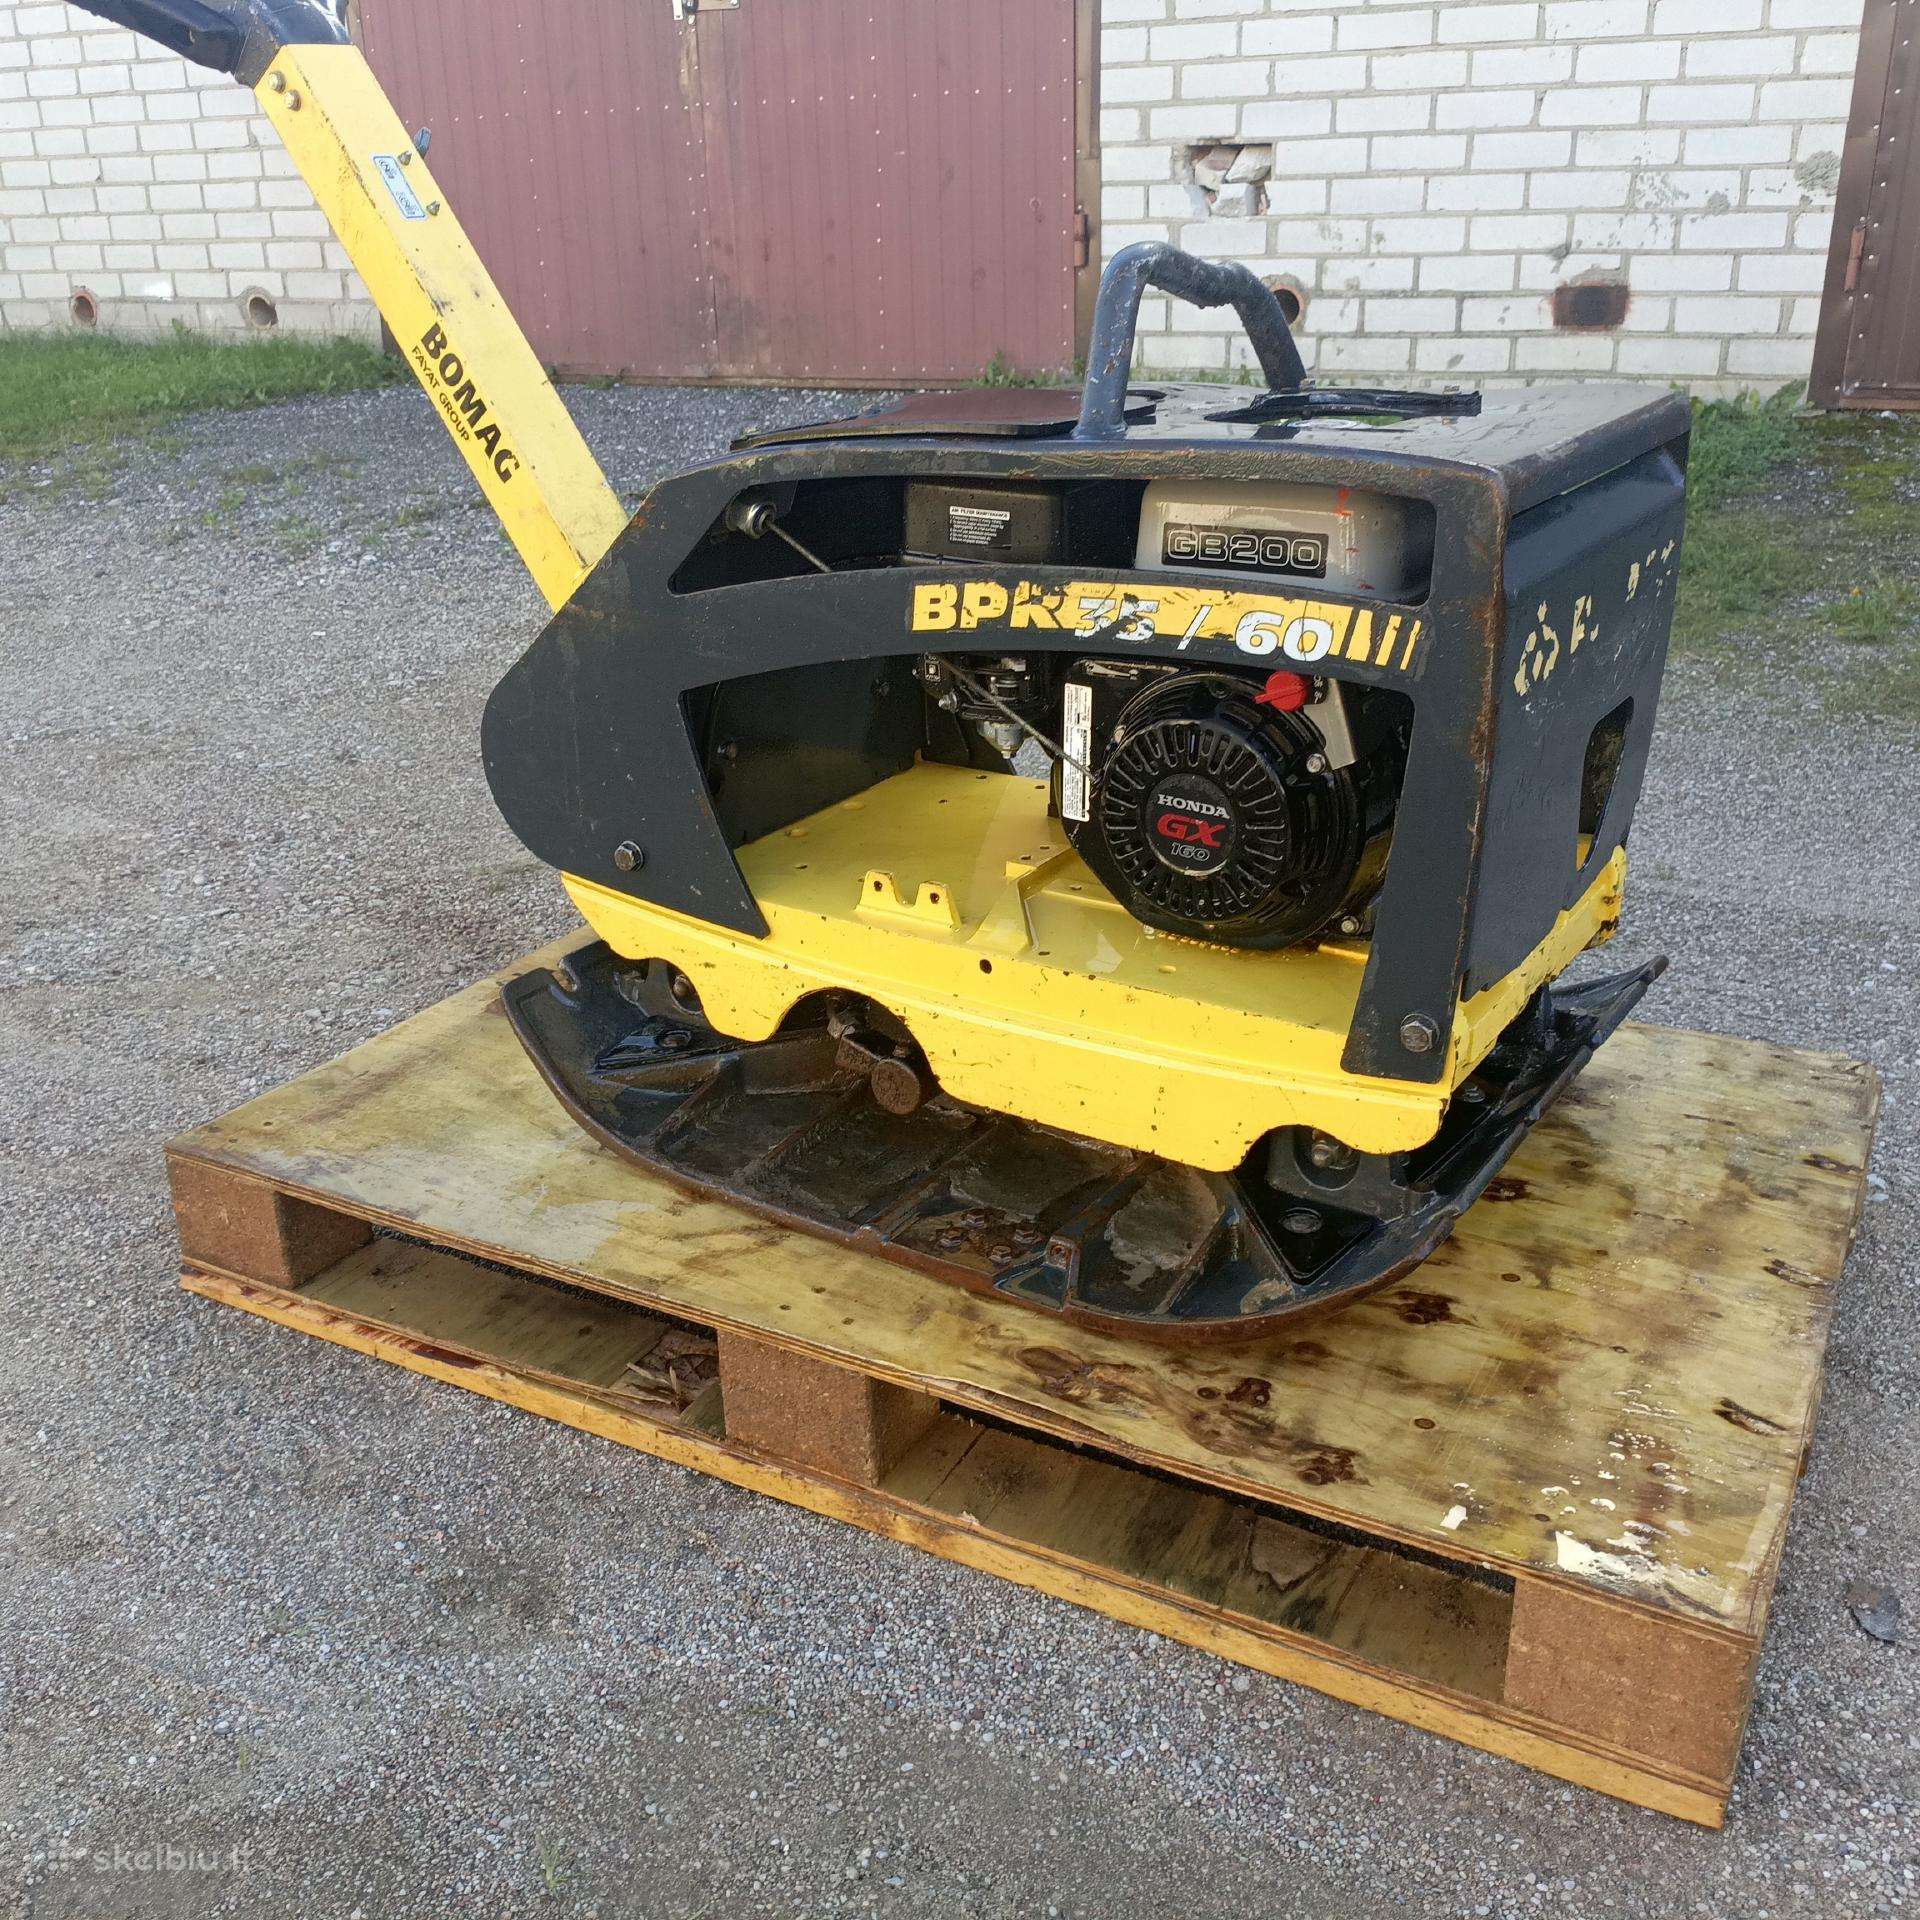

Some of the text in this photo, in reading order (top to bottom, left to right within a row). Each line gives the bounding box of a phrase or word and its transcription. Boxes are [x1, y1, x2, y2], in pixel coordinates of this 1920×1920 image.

[412, 345, 470, 441] FAYAT GROUP
[421, 322, 520, 484] BOMAG
[1167, 529, 1323, 569] GB200
[1157, 793, 1231, 819] HONDA
[1157, 813, 1227, 848] GX
[1171, 841, 1211, 861] 160
